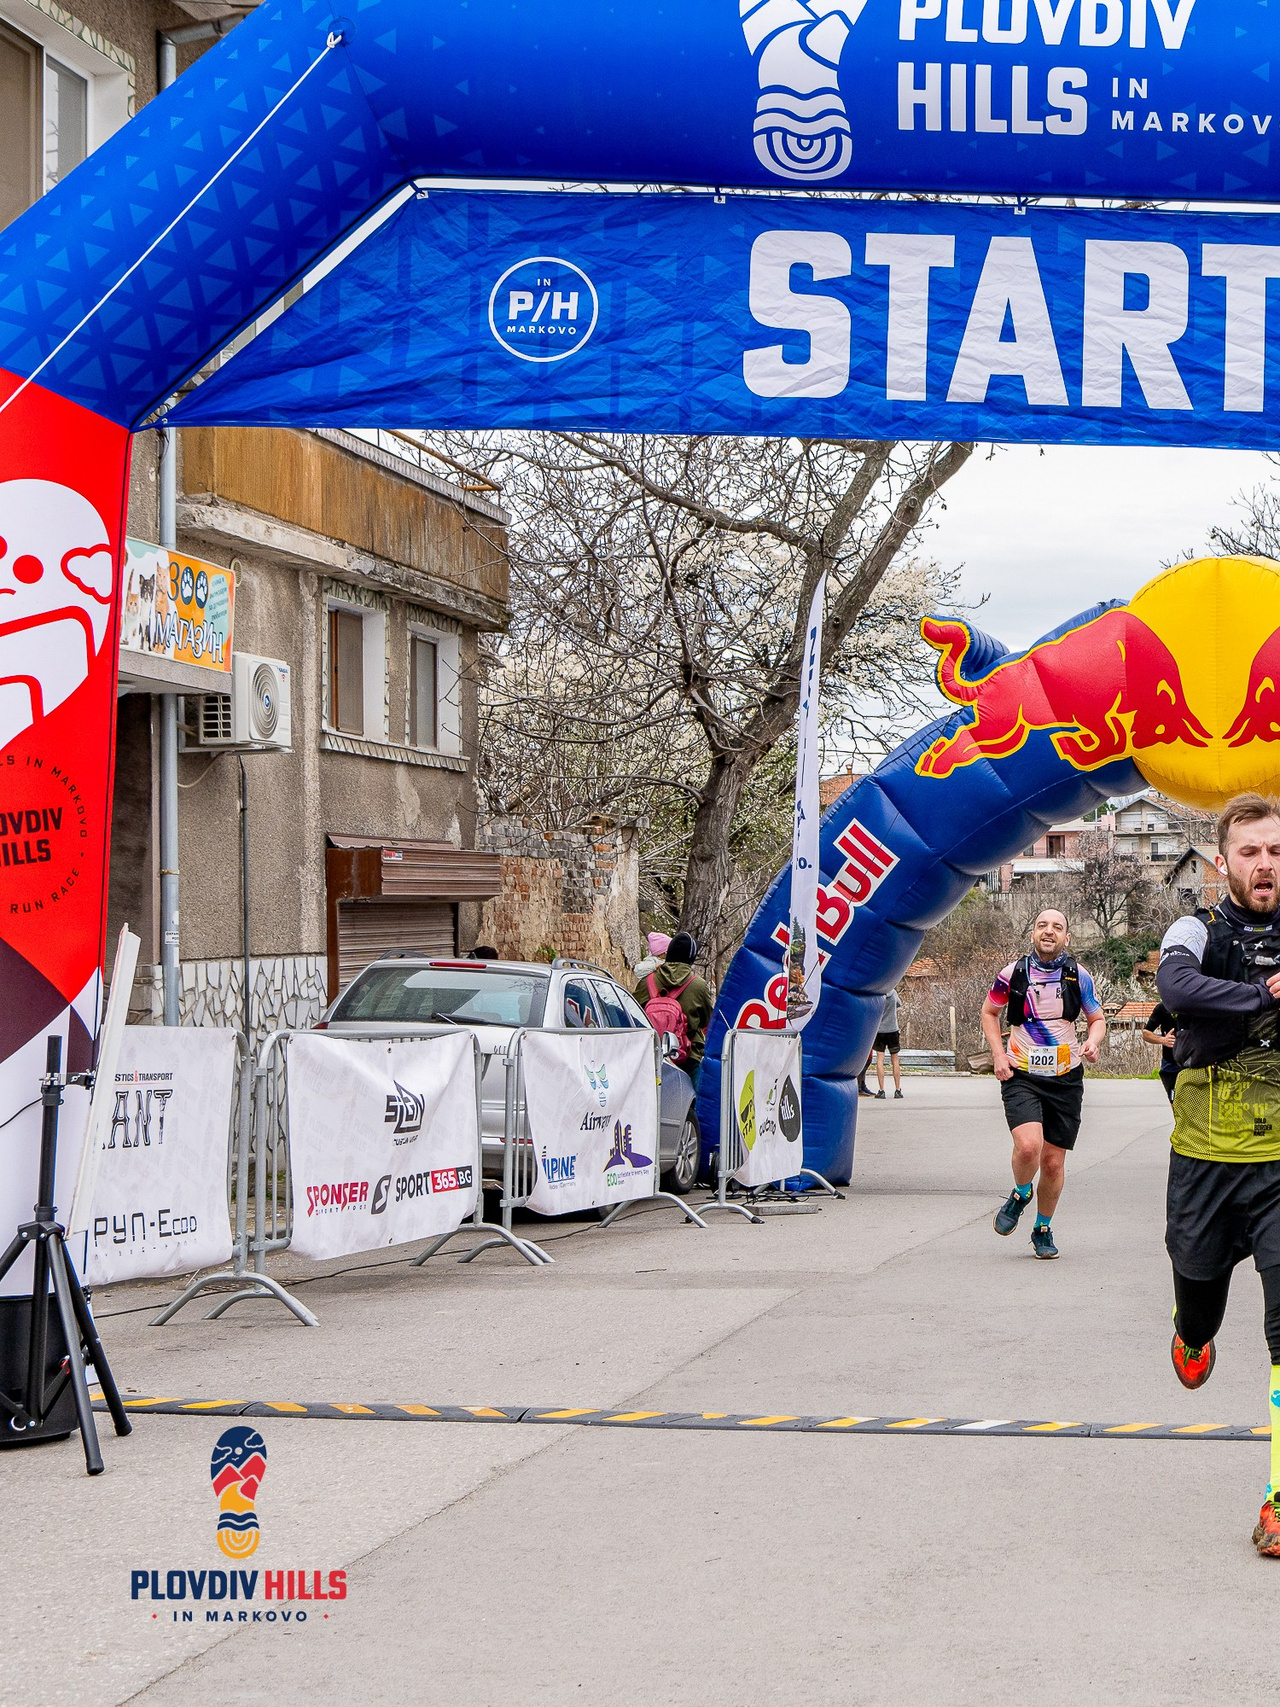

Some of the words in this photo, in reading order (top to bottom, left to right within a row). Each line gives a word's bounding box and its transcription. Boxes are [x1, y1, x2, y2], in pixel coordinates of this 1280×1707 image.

[898, 0, 1196, 49] PLOVDIV
[898, 61, 1088, 135] HILLS
[1112, 77, 1148, 99] IN
[537, 278, 551, 286] IN
[508, 290, 579, 323] P/H
[507, 325, 577, 335] MARKOVO
[154, 610, 224, 663] МАГАЗИН
[26, 756, 44, 769] IN
[51, 766, 88, 838] MARKOVO
[0, 839, 52, 867] ILLS
[10, 900, 44, 914] RUN
[51, 867, 80, 903] RACE
[816, 824, 895, 940] Bull
[139, 1072, 173, 1081] TRANSPORT
[1030, 1055, 1054, 1066] 1202
[102, 1089, 173, 1149] ANT
[306, 1181, 370, 1217] SPONSER
